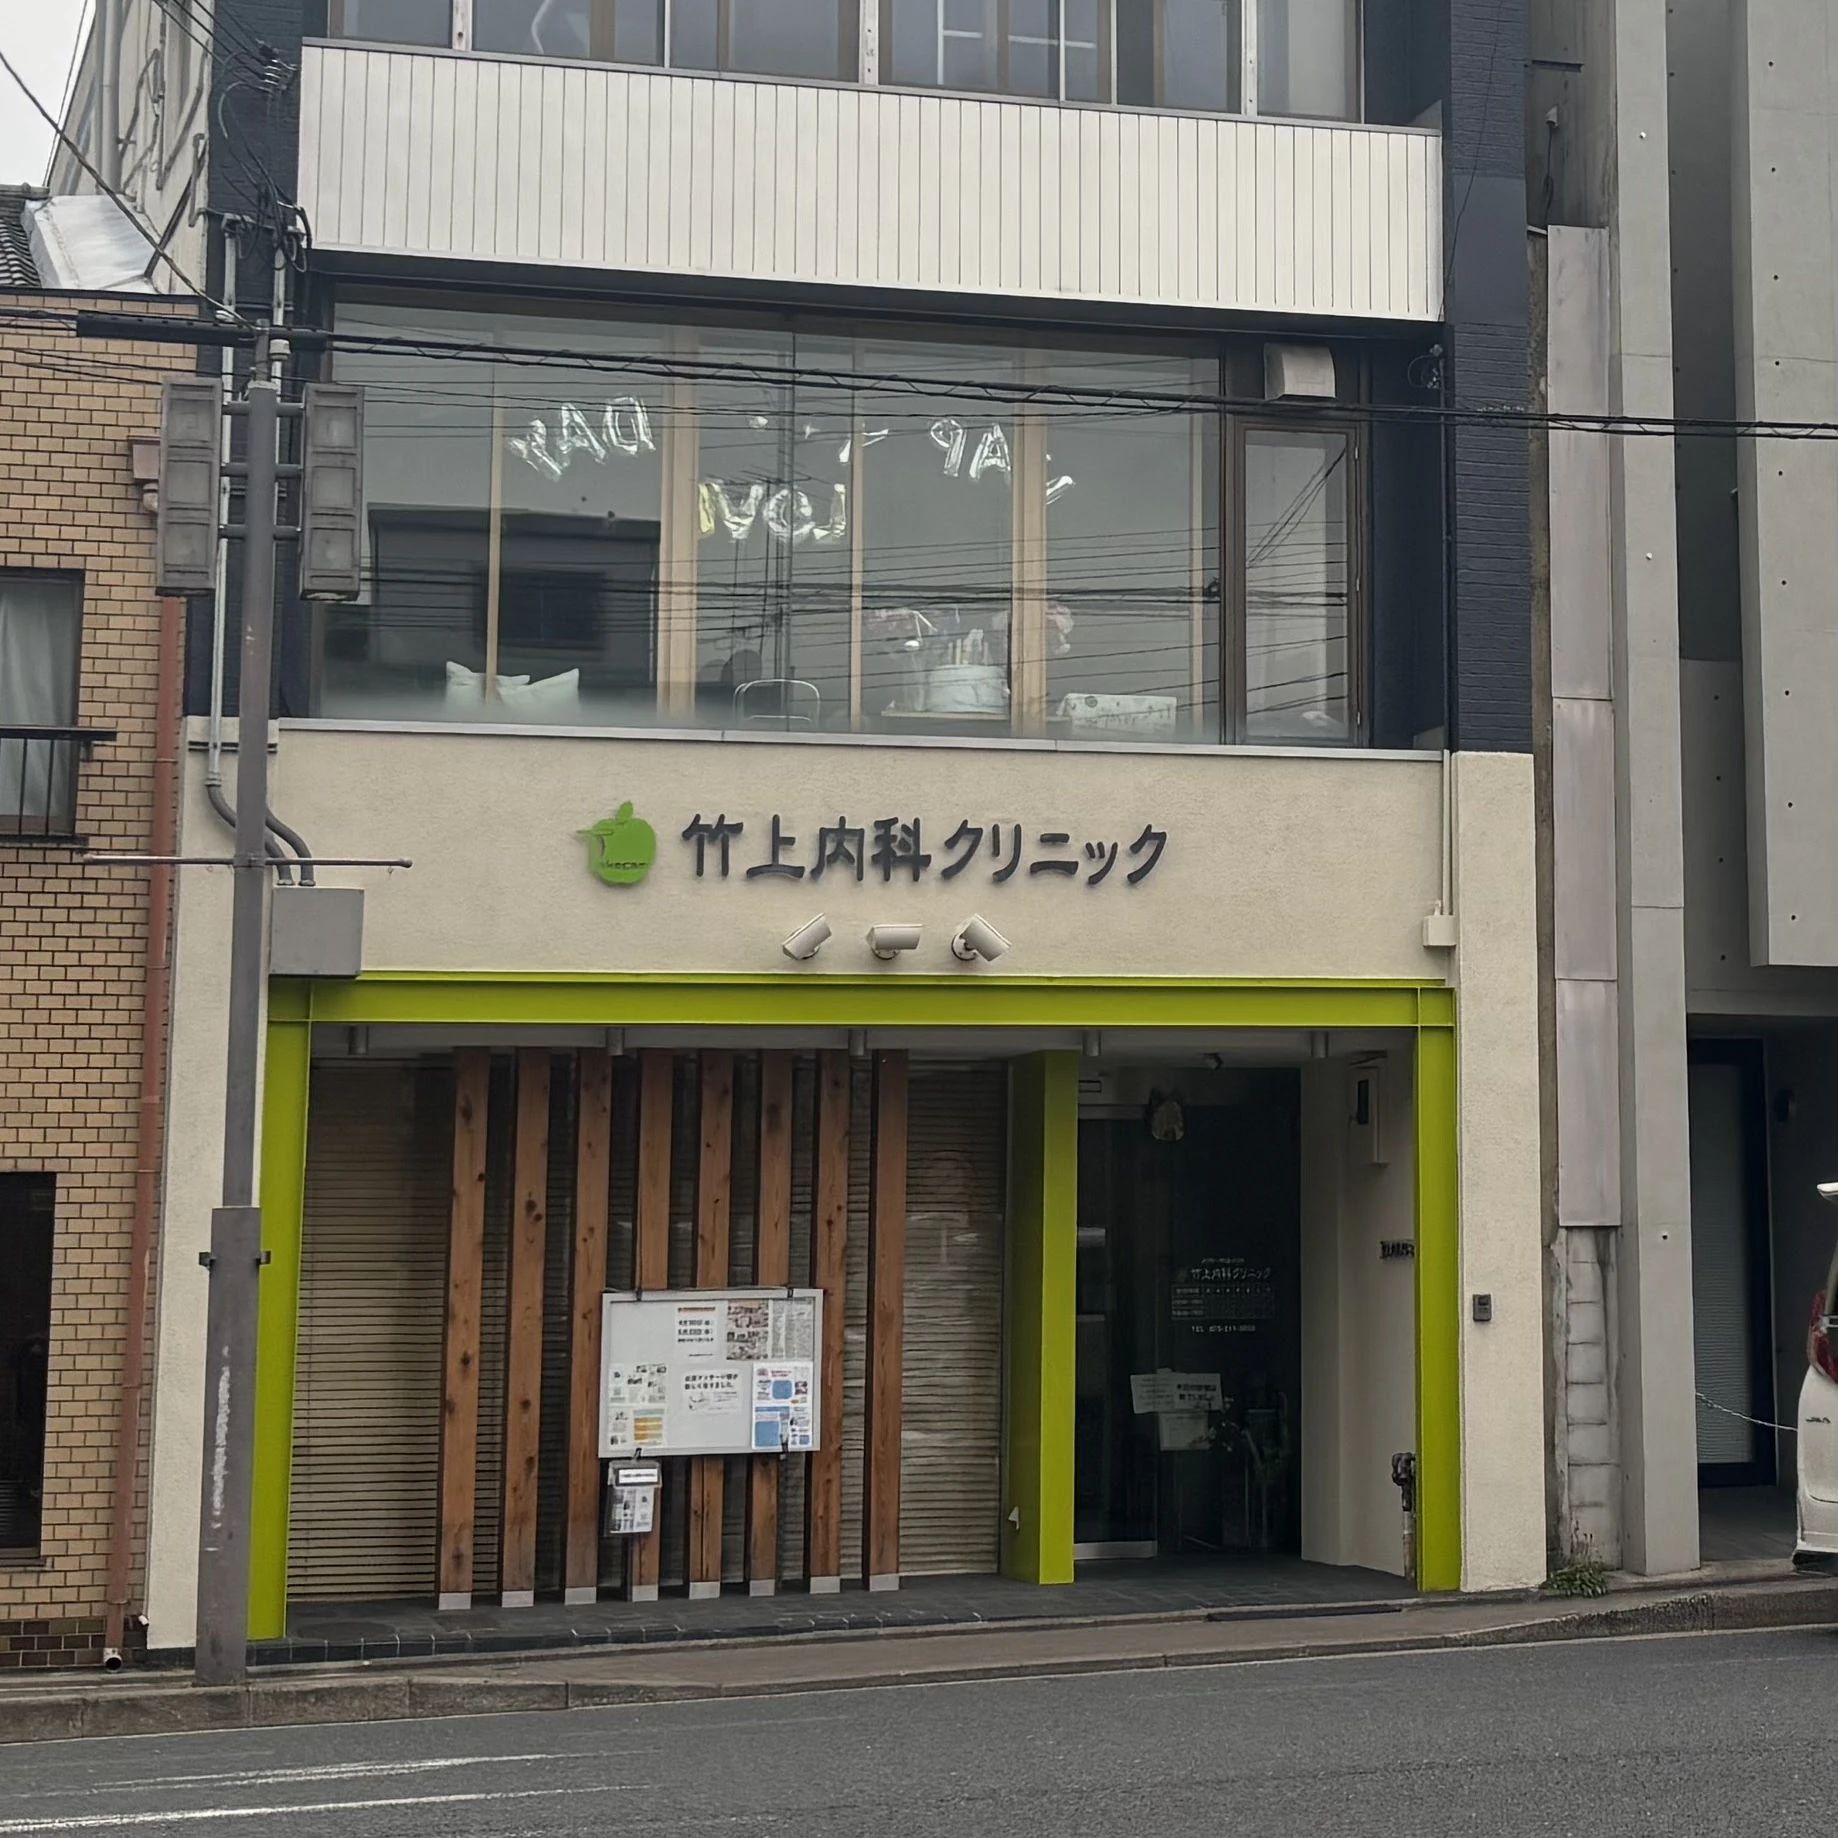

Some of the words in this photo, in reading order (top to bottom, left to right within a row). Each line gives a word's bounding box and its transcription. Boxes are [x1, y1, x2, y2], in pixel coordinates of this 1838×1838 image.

[681, 813, 1168, 885] 竹上内科クリニック
